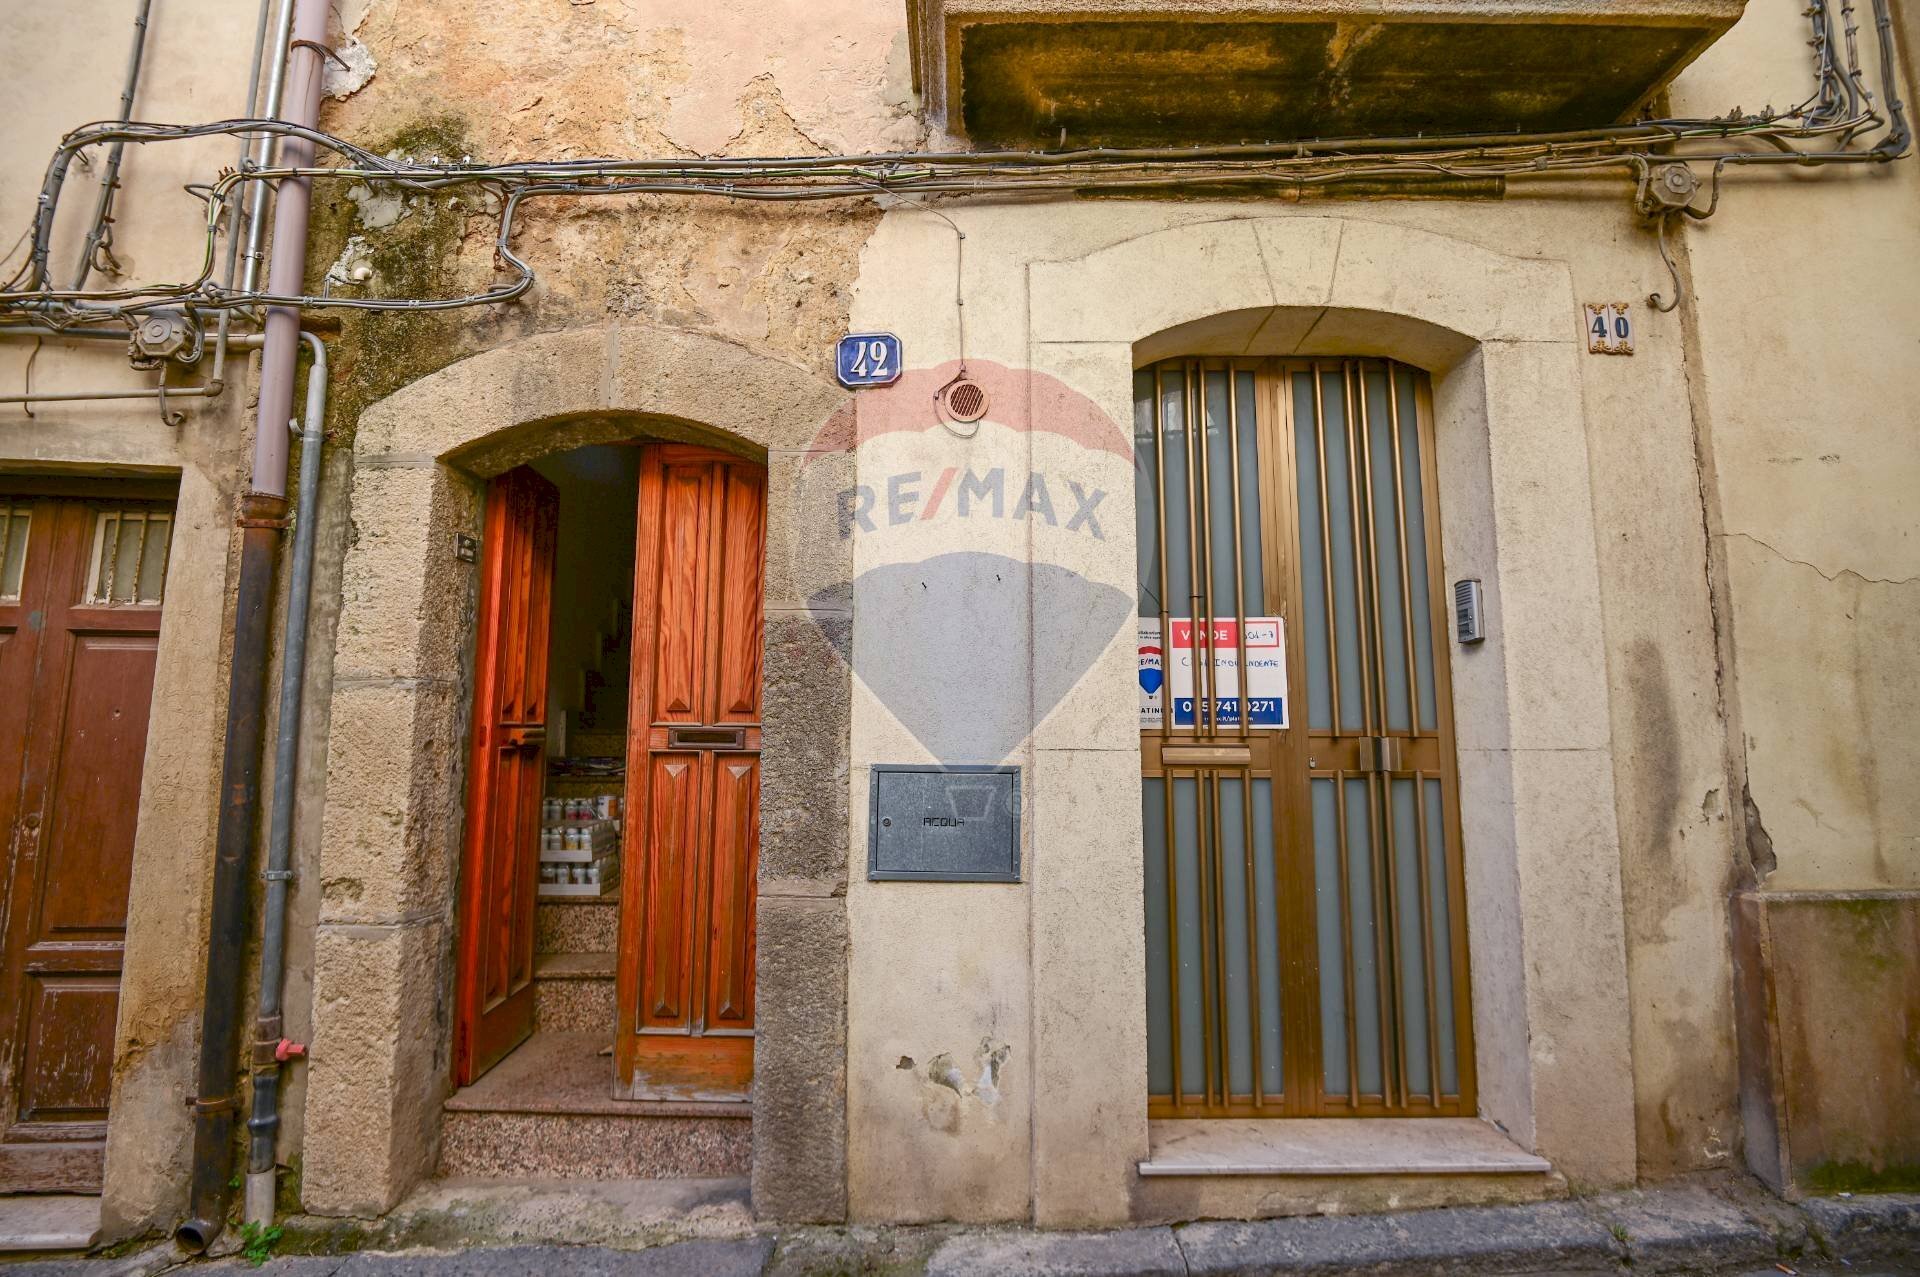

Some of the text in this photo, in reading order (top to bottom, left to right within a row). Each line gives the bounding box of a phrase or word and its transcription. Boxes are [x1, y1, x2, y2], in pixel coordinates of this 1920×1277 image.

[1591, 315, 1630, 339] 40
[850, 341, 888, 377] 42
[1180, 629, 1228, 641] VNDE
[923, 817, 965, 827] ACQUA
